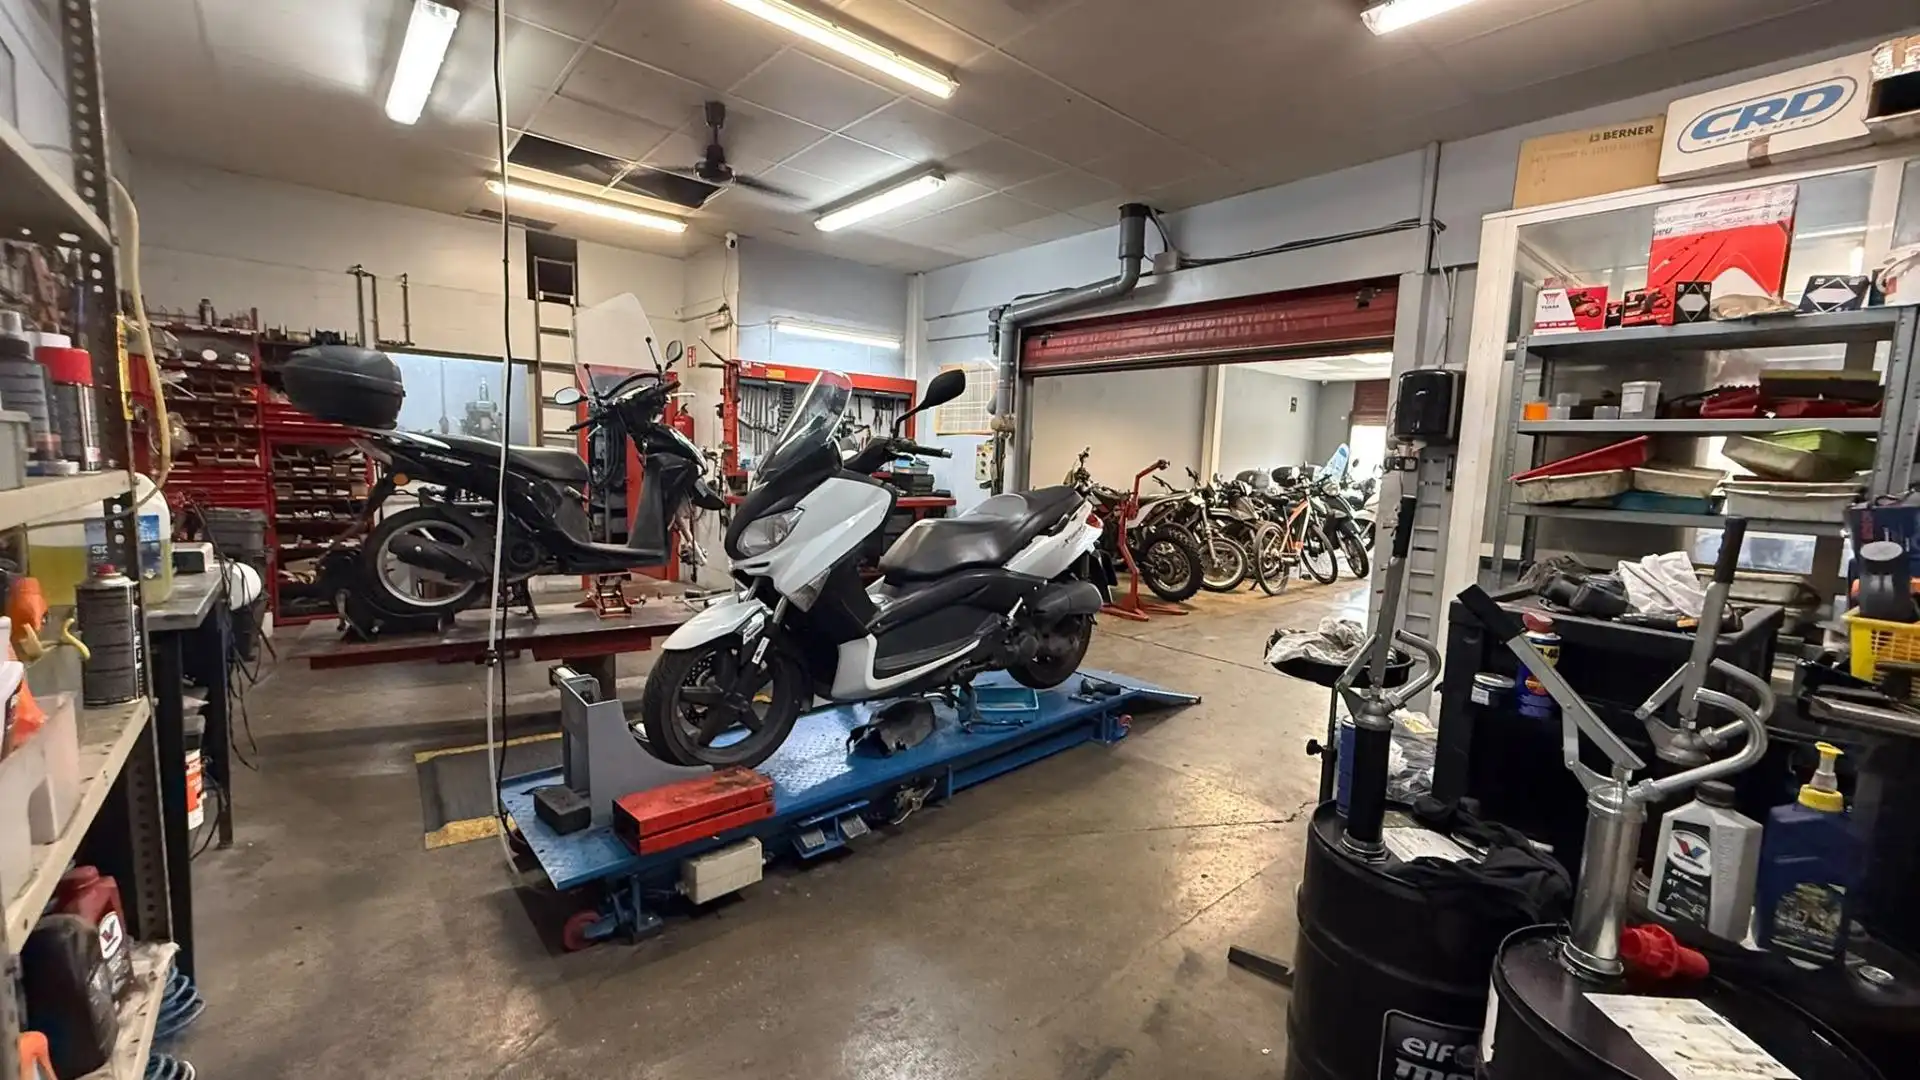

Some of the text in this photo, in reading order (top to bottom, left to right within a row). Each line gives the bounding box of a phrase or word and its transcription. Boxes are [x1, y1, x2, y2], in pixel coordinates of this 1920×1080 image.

[1691, 84, 1845, 141] CRD
[1602, 124, 1655, 141] BERNER
[1401, 1037, 1456, 1063] elf
